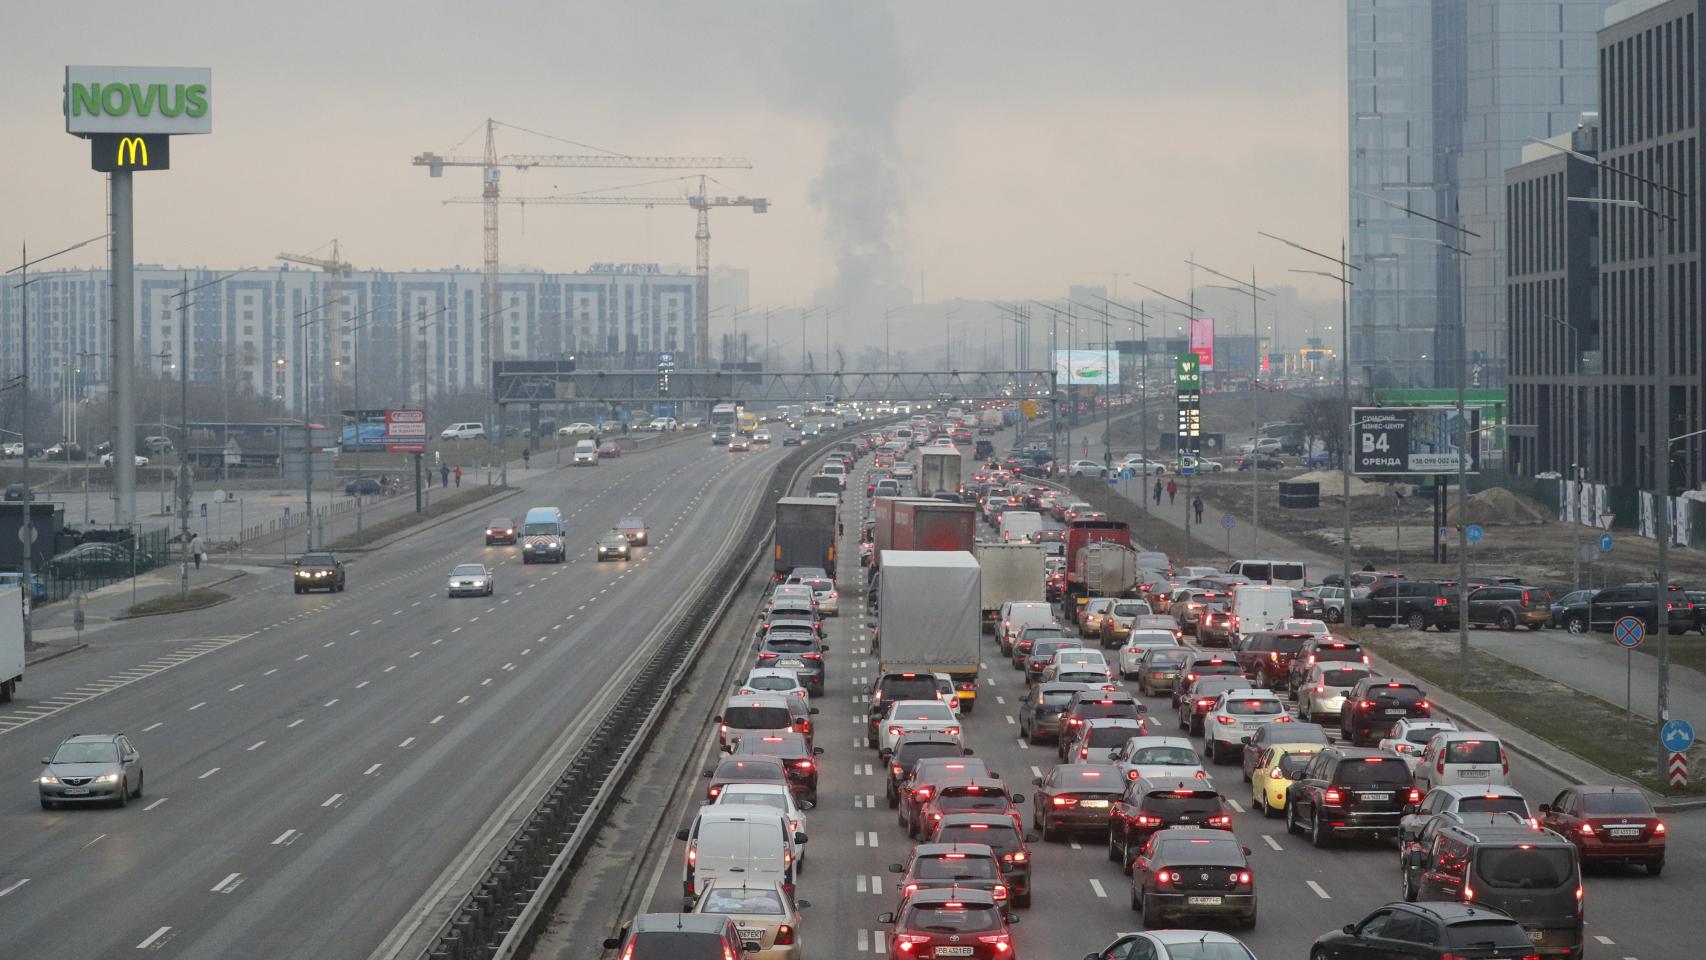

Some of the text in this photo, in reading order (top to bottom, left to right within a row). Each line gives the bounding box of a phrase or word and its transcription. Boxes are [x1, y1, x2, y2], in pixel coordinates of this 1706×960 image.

[71, 82, 208, 118] NOVUS
[1362, 433, 1390, 453] B4
[1362, 458, 1401, 466] ОРЕНДА
